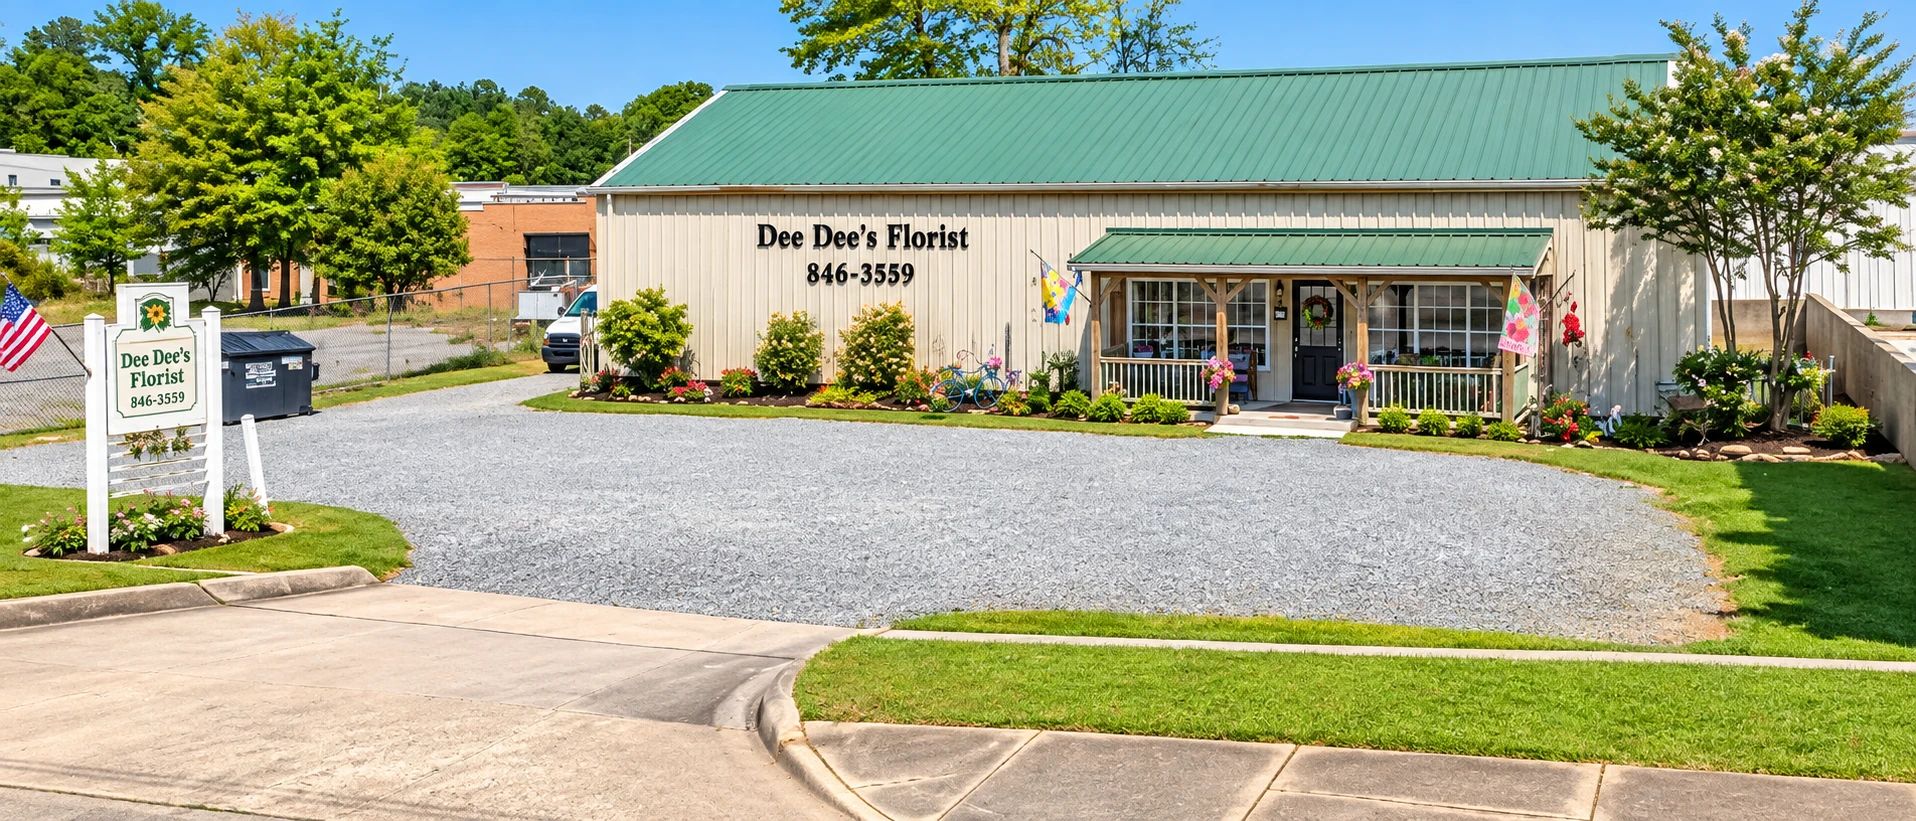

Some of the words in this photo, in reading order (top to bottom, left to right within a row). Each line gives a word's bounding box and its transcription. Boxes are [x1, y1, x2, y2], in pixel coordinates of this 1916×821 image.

[757, 223, 804, 248] Dee
[813, 223, 878, 249] Dee's
[887, 223, 970, 249] Florist
[807, 262, 915, 285] 846-3559
[120, 352, 149, 369] Dee
[152, 346, 191, 366] Dee's
[130, 367, 185, 388] Florist
[130, 391, 185, 409] 846-3559
